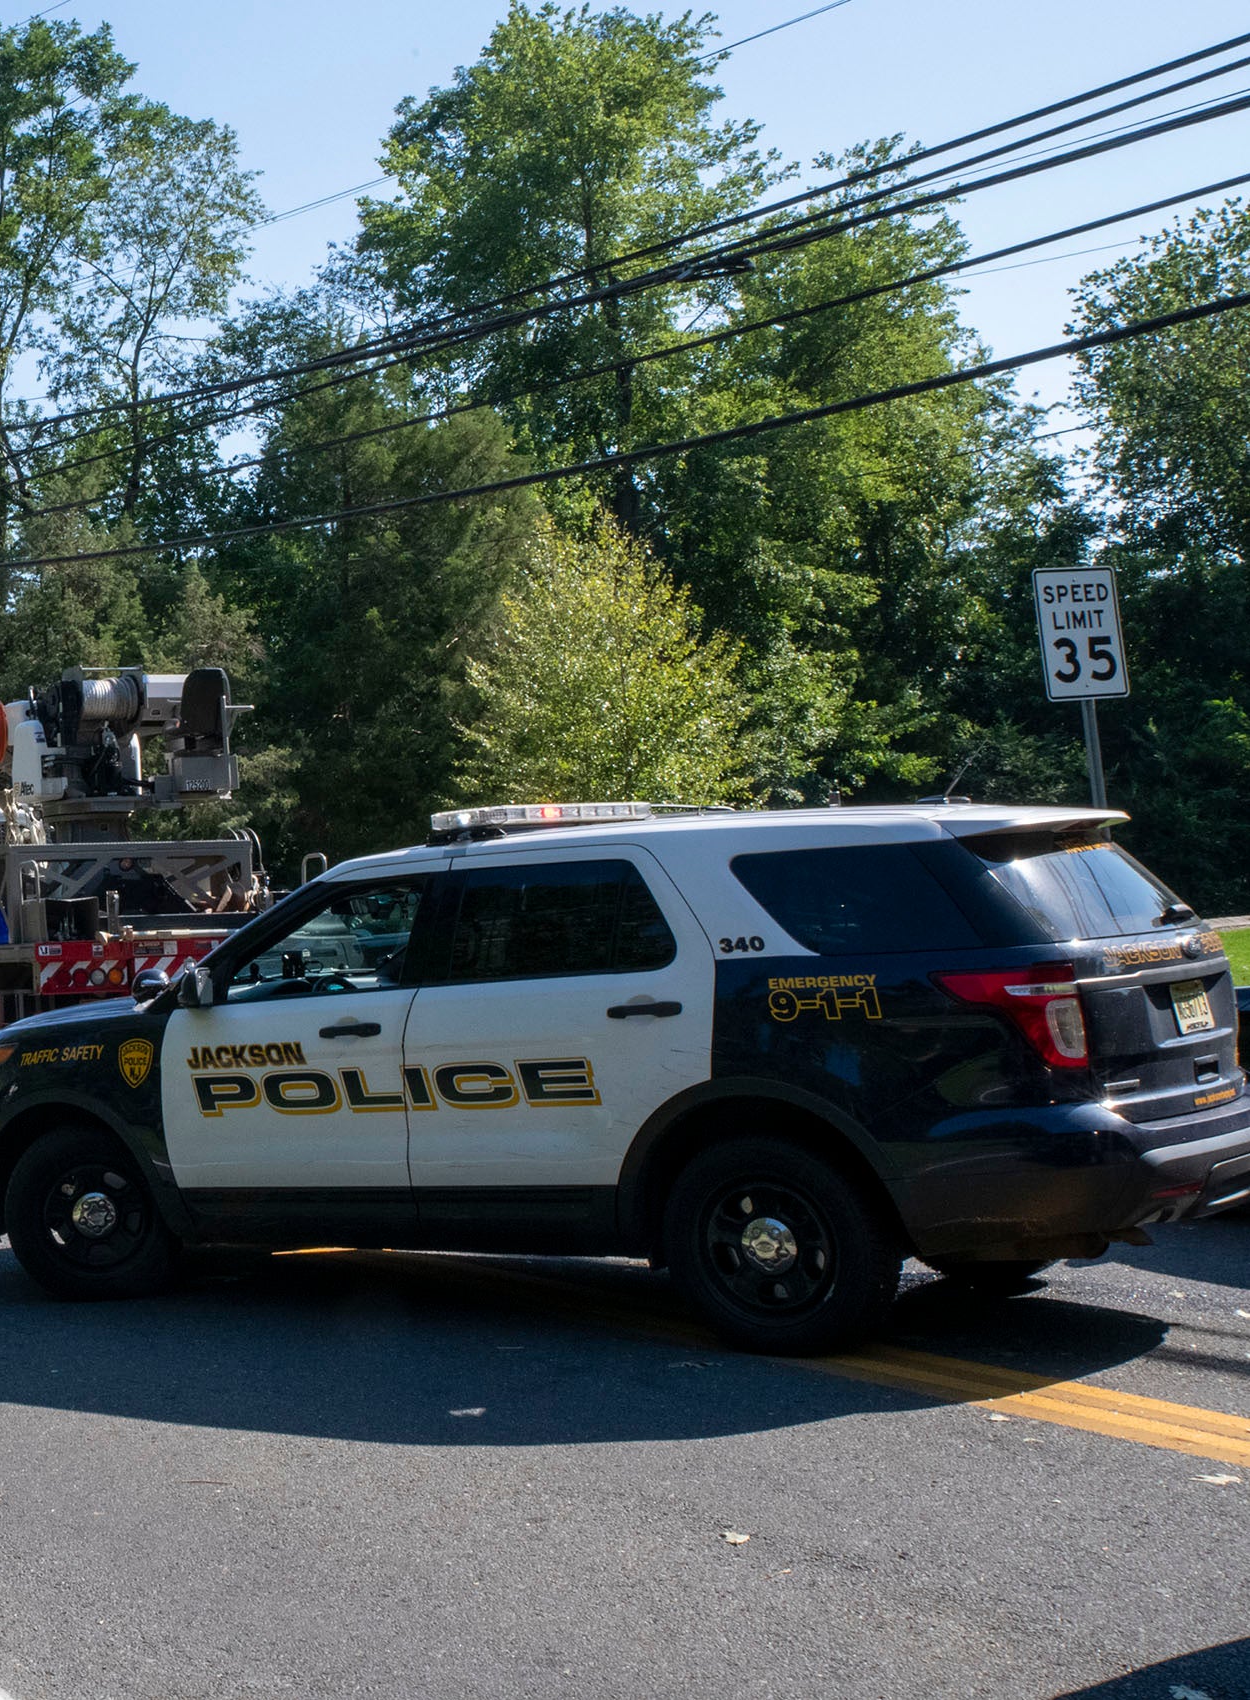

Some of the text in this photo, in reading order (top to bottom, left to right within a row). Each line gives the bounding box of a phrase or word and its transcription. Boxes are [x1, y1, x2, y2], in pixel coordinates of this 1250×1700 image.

[1043, 583, 1108, 604] SPEED
[1052, 610, 1104, 631] LIMIT
[1053, 636, 1117, 683] 35
[718, 935, 765, 954] 340
[1102, 940, 1183, 968] JACKSON
[768, 974, 877, 989] EMERGENCY
[768, 986, 883, 1022] 9-1-1
[20, 1044, 104, 1066] TRAFFIC SAFETY
[124, 1056, 147, 1066] POLICE
[186, 1041, 308, 1070] JACKSON
[190, 1056, 603, 1118] POLICE
